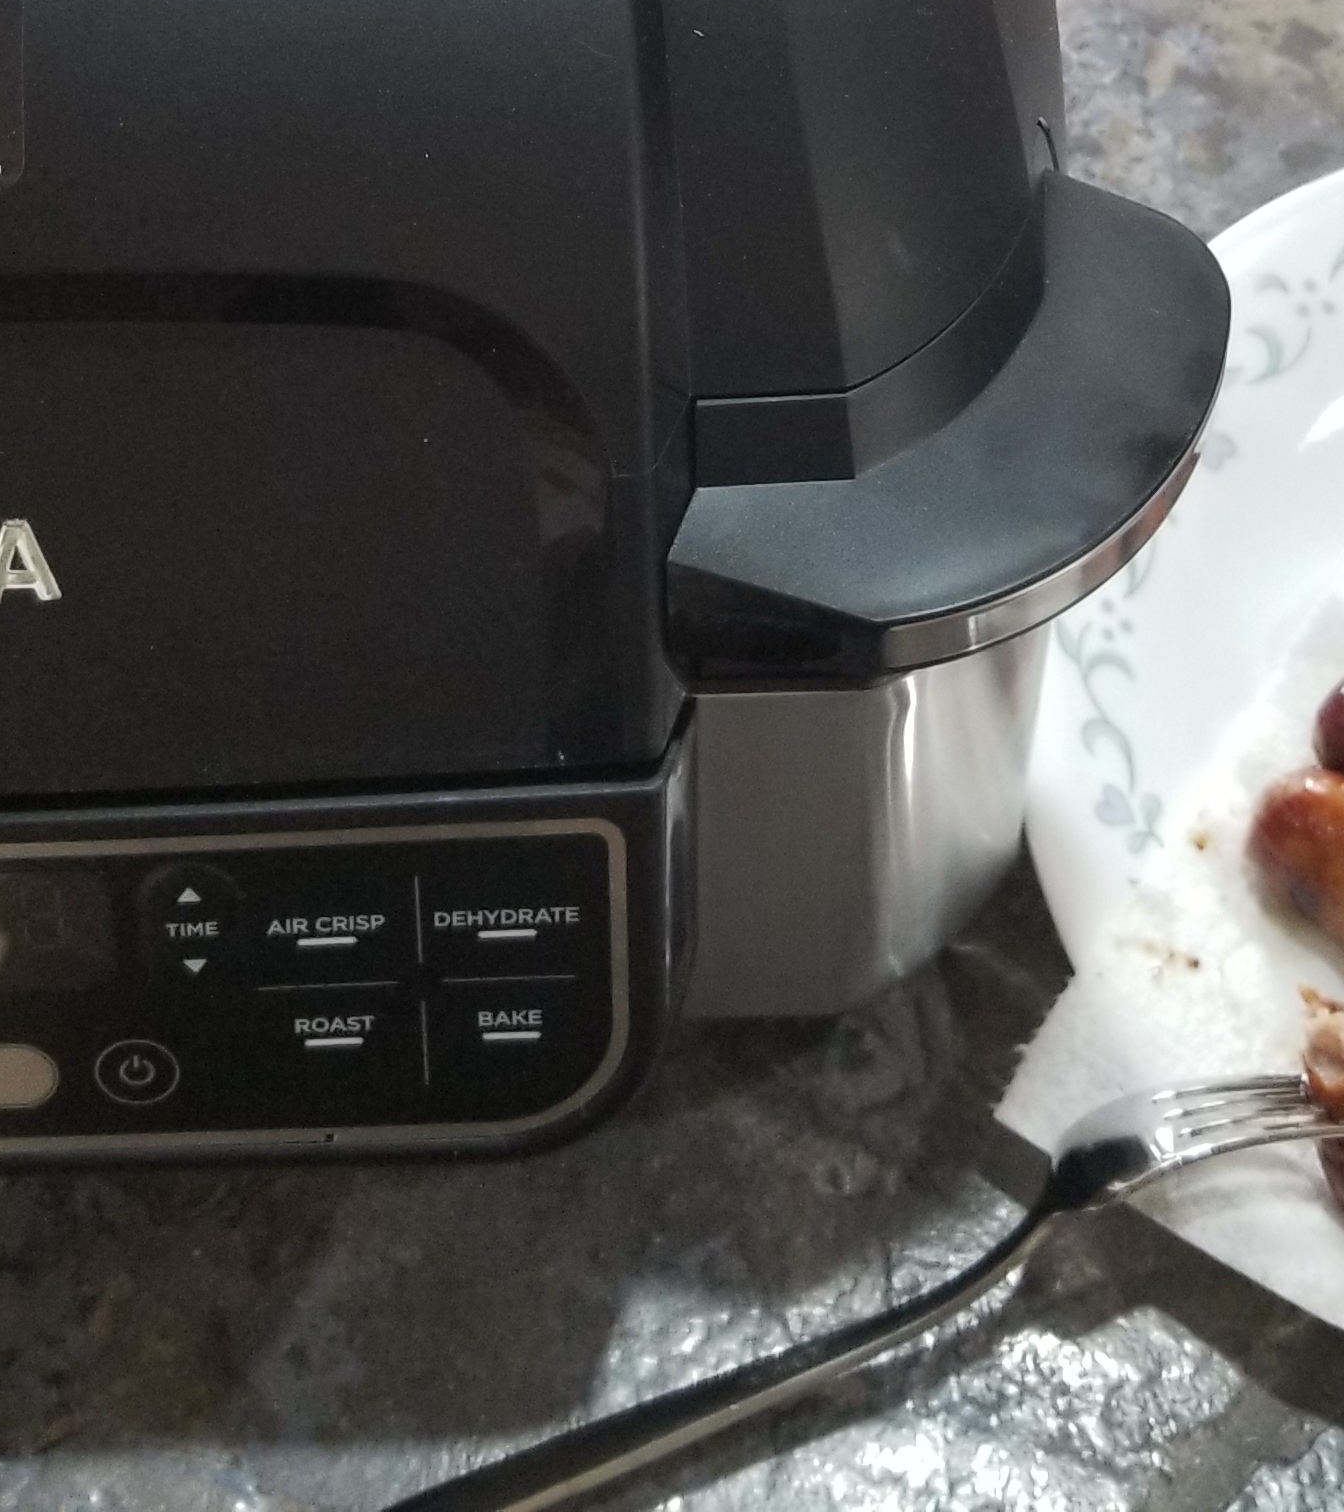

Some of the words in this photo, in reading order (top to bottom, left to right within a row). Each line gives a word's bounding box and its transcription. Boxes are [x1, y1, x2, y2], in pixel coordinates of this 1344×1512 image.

[267, 918, 309, 936] AIR
[315, 914, 386, 932] CRISP
[433, 906, 580, 927] DEHYDRATE
[165, 921, 219, 937] TIME
[294, 1015, 375, 1033] ROAST
[478, 1009, 543, 1027] BAKE
